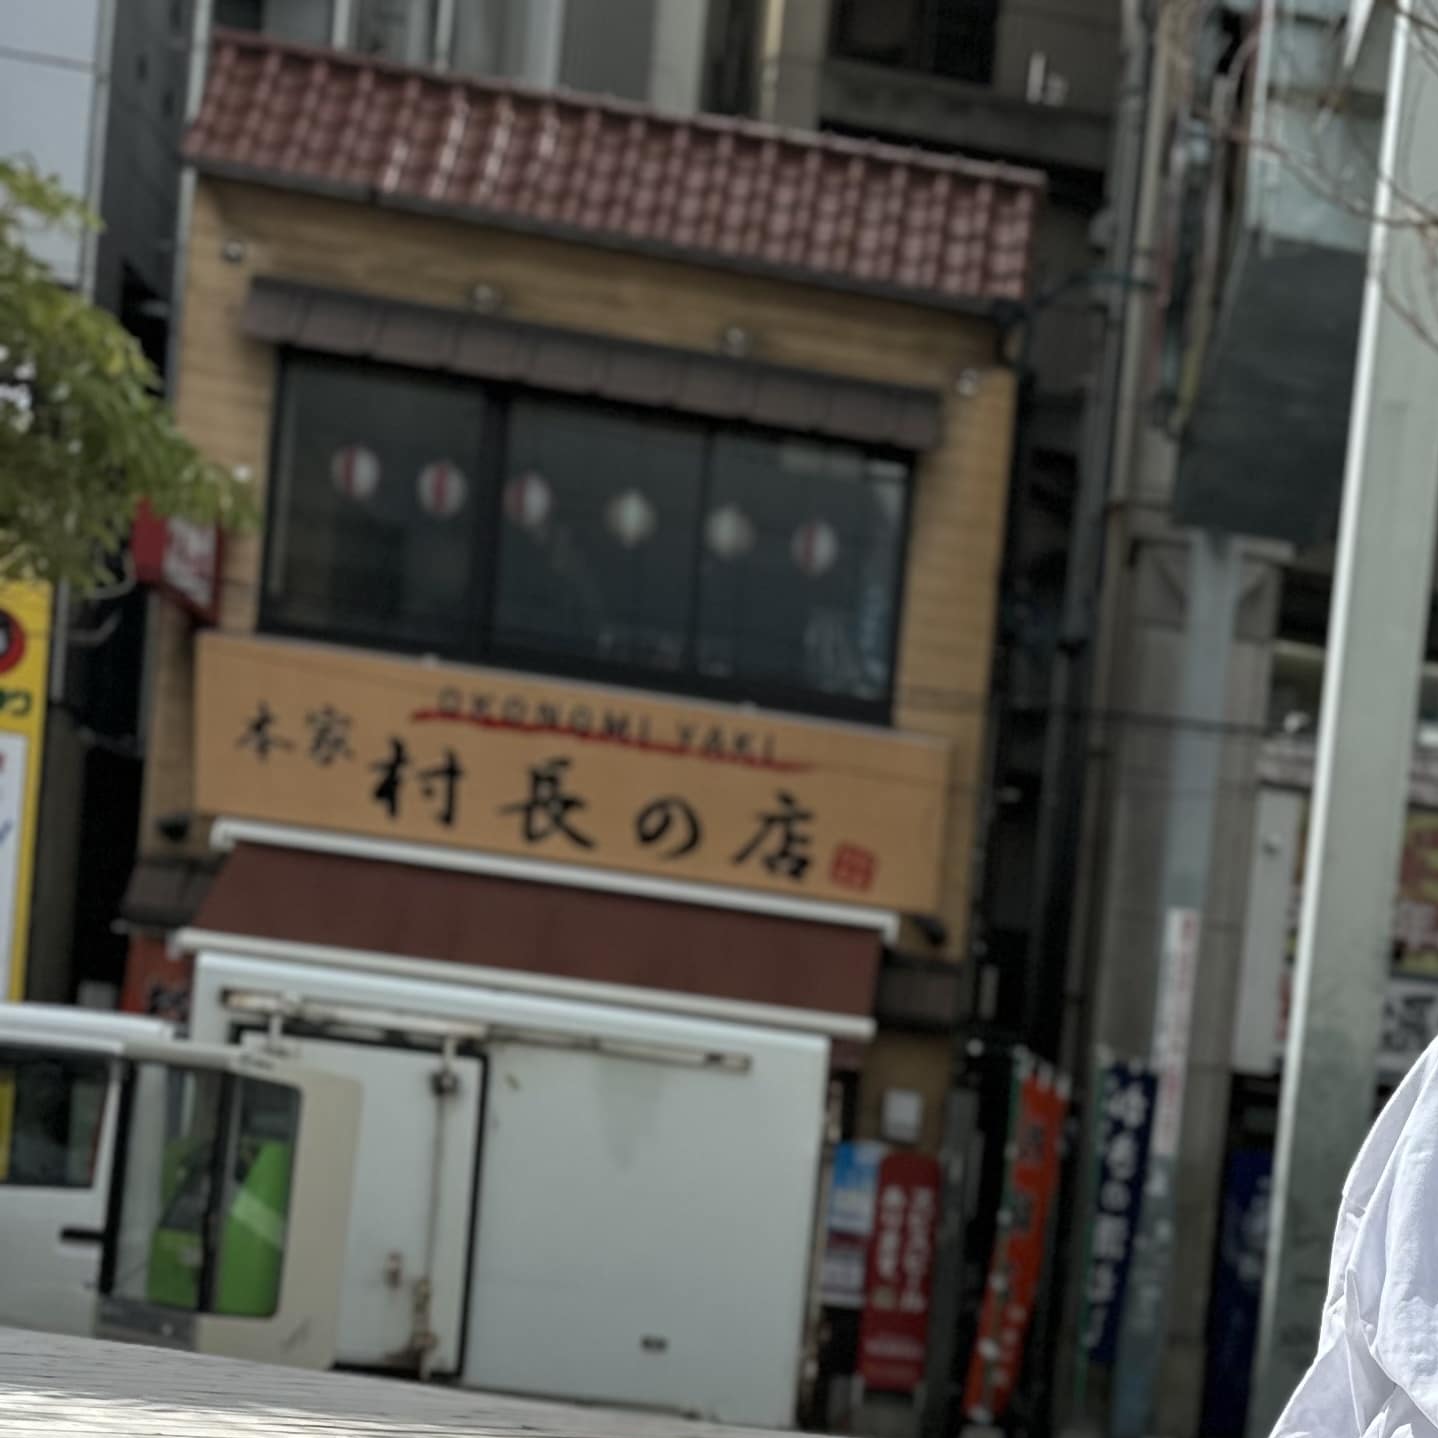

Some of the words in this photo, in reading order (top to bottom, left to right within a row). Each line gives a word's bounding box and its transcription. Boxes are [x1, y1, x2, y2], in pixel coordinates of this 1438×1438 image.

[438, 686, 653, 738] OKONOMI
[676, 718, 782, 762] YAKI
[236, 702, 358, 767] 本家
[367, 738, 816, 880] 村長の店
